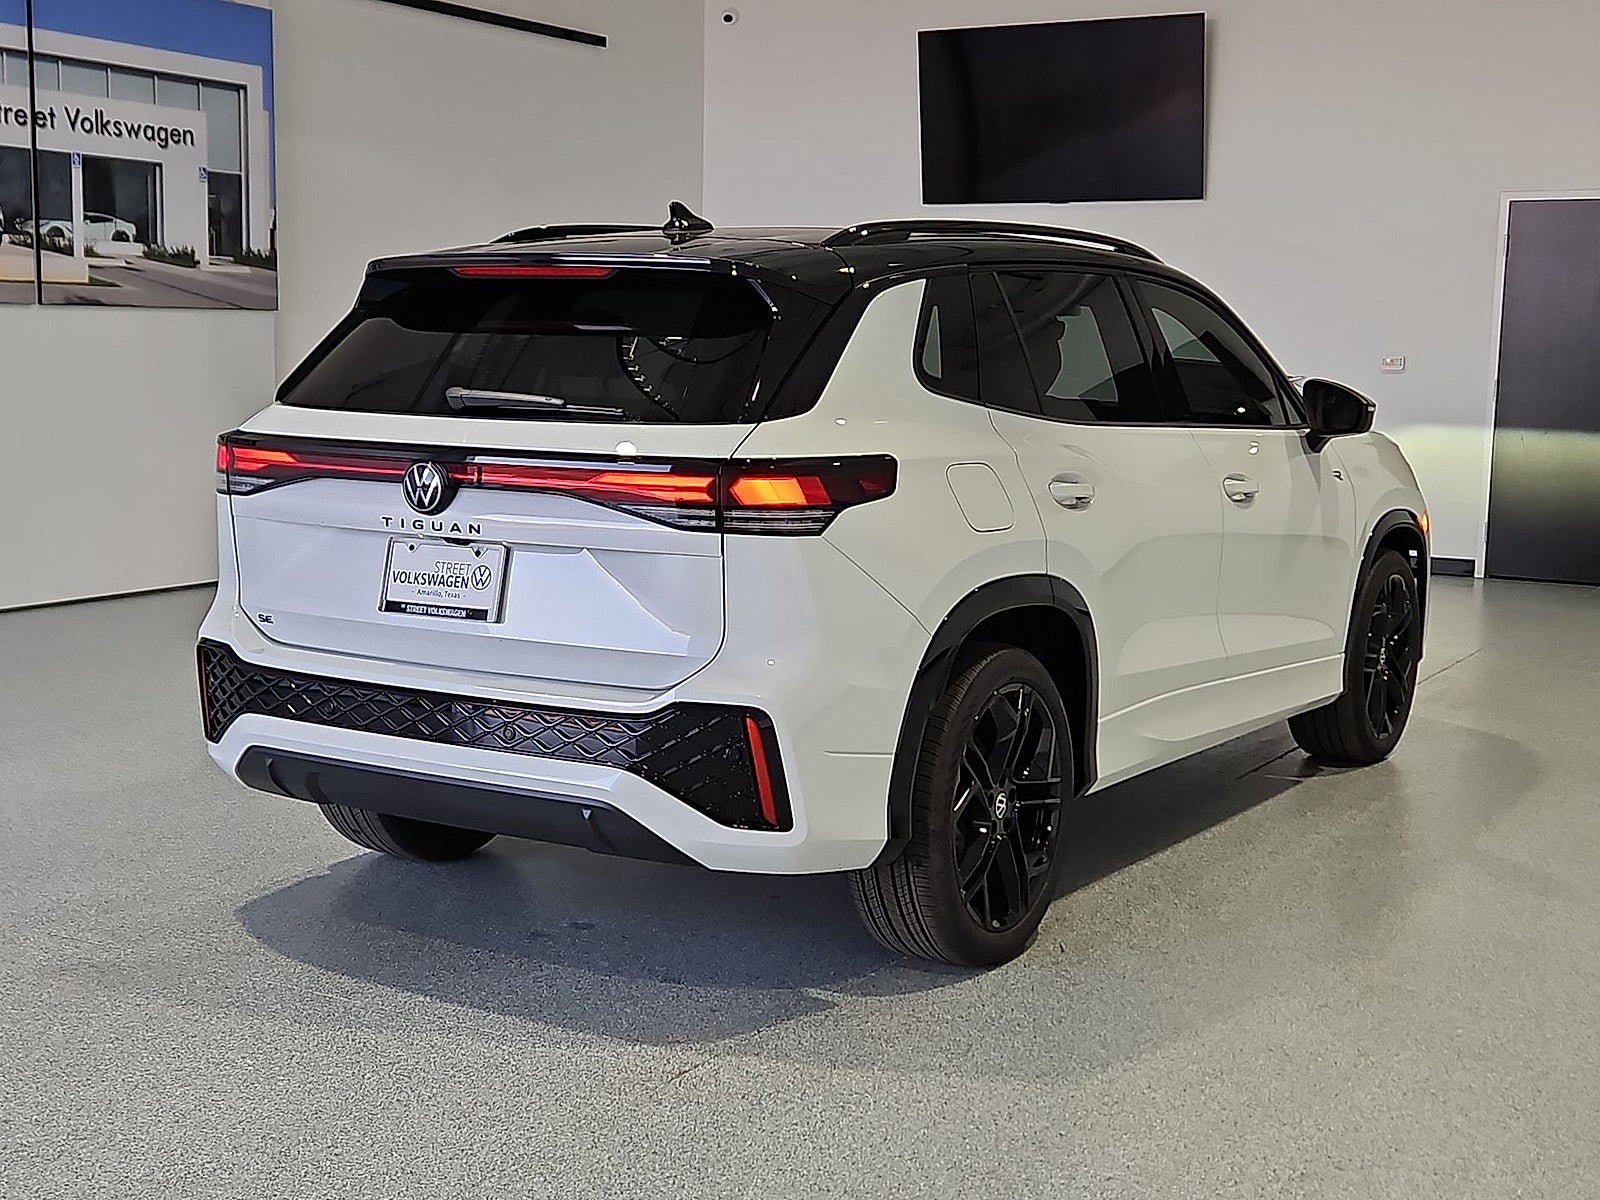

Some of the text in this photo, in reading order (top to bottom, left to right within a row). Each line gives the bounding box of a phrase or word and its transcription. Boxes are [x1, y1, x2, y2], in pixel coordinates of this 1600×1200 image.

[0, 103, 195, 148] reet Volkswagen
[381, 516, 481, 535] TIGUAN
[434, 561, 471, 576] STREET
[392, 570, 470, 589] VOLKSWAGEN
[445, 590, 461, 599] Texas
[406, 604, 466, 617] STREET VOLKSWAGEN
[258, 614, 274, 624] SE
